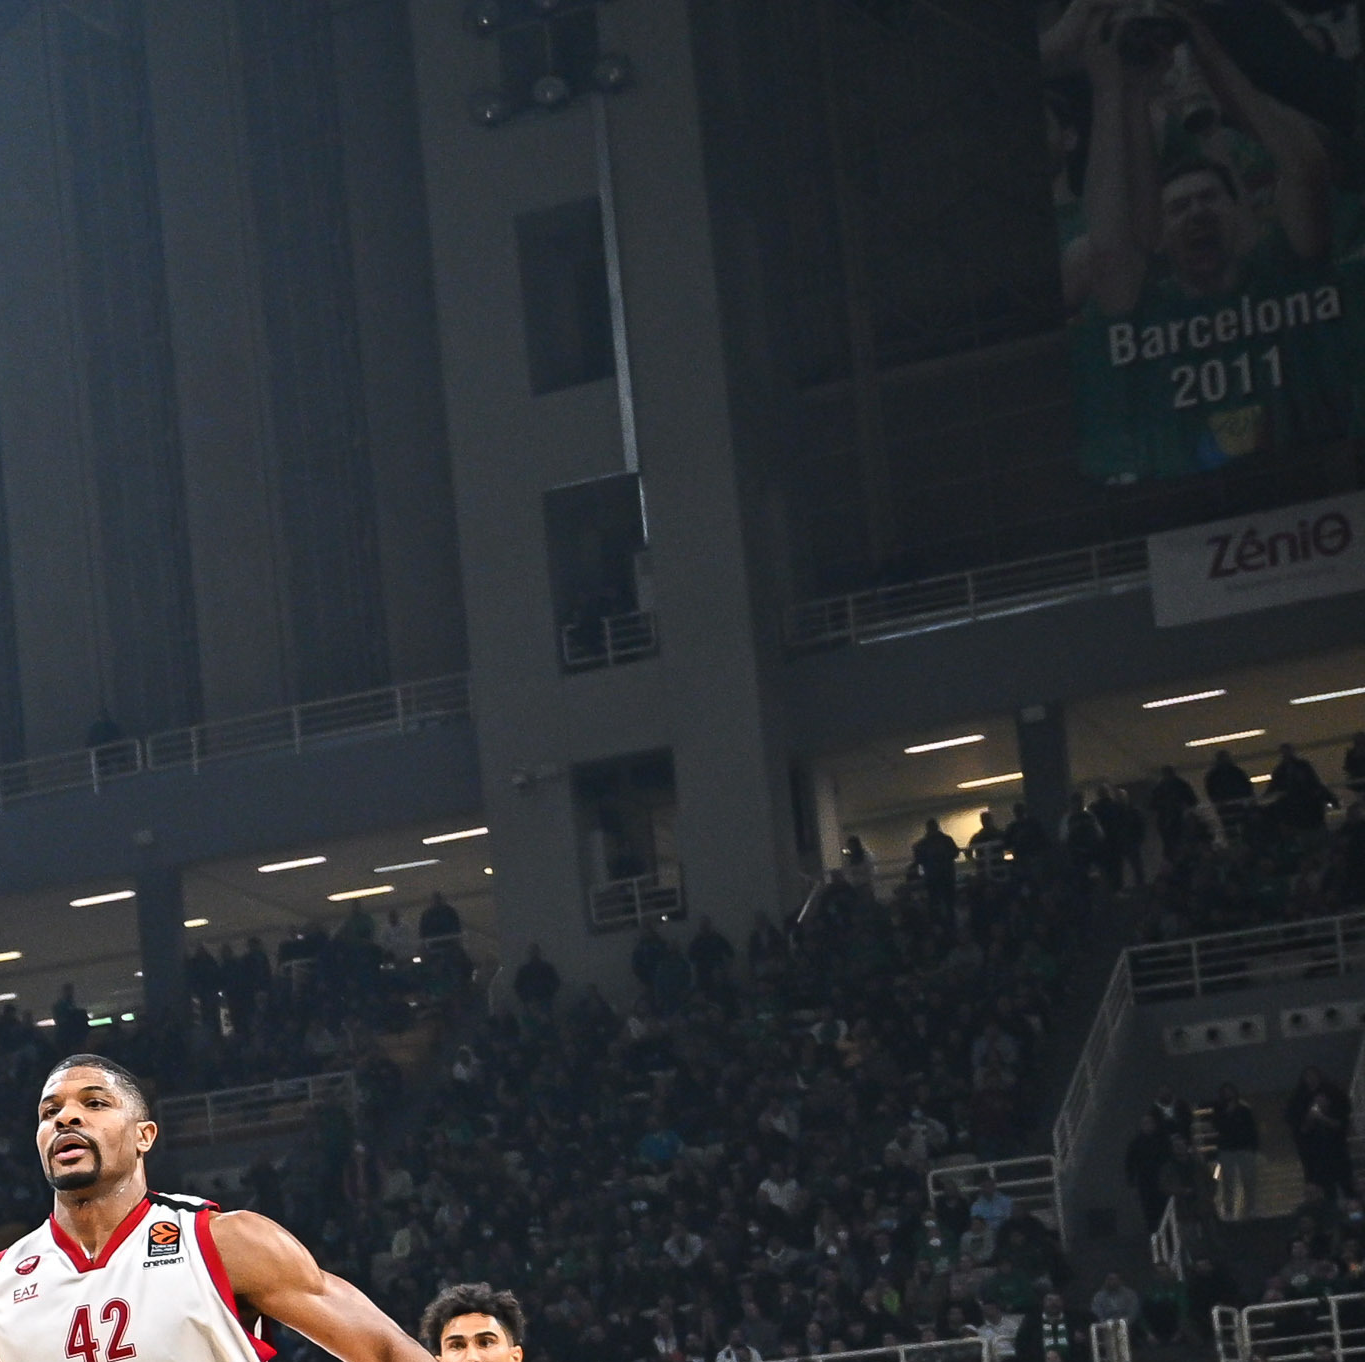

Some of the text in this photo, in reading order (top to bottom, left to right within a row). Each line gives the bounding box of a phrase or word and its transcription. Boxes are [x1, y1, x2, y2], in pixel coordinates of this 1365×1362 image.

[1108, 286, 1342, 366] Barcelona
[1171, 344, 1284, 408] 2011
[13, 1283, 38, 1301] EA7
